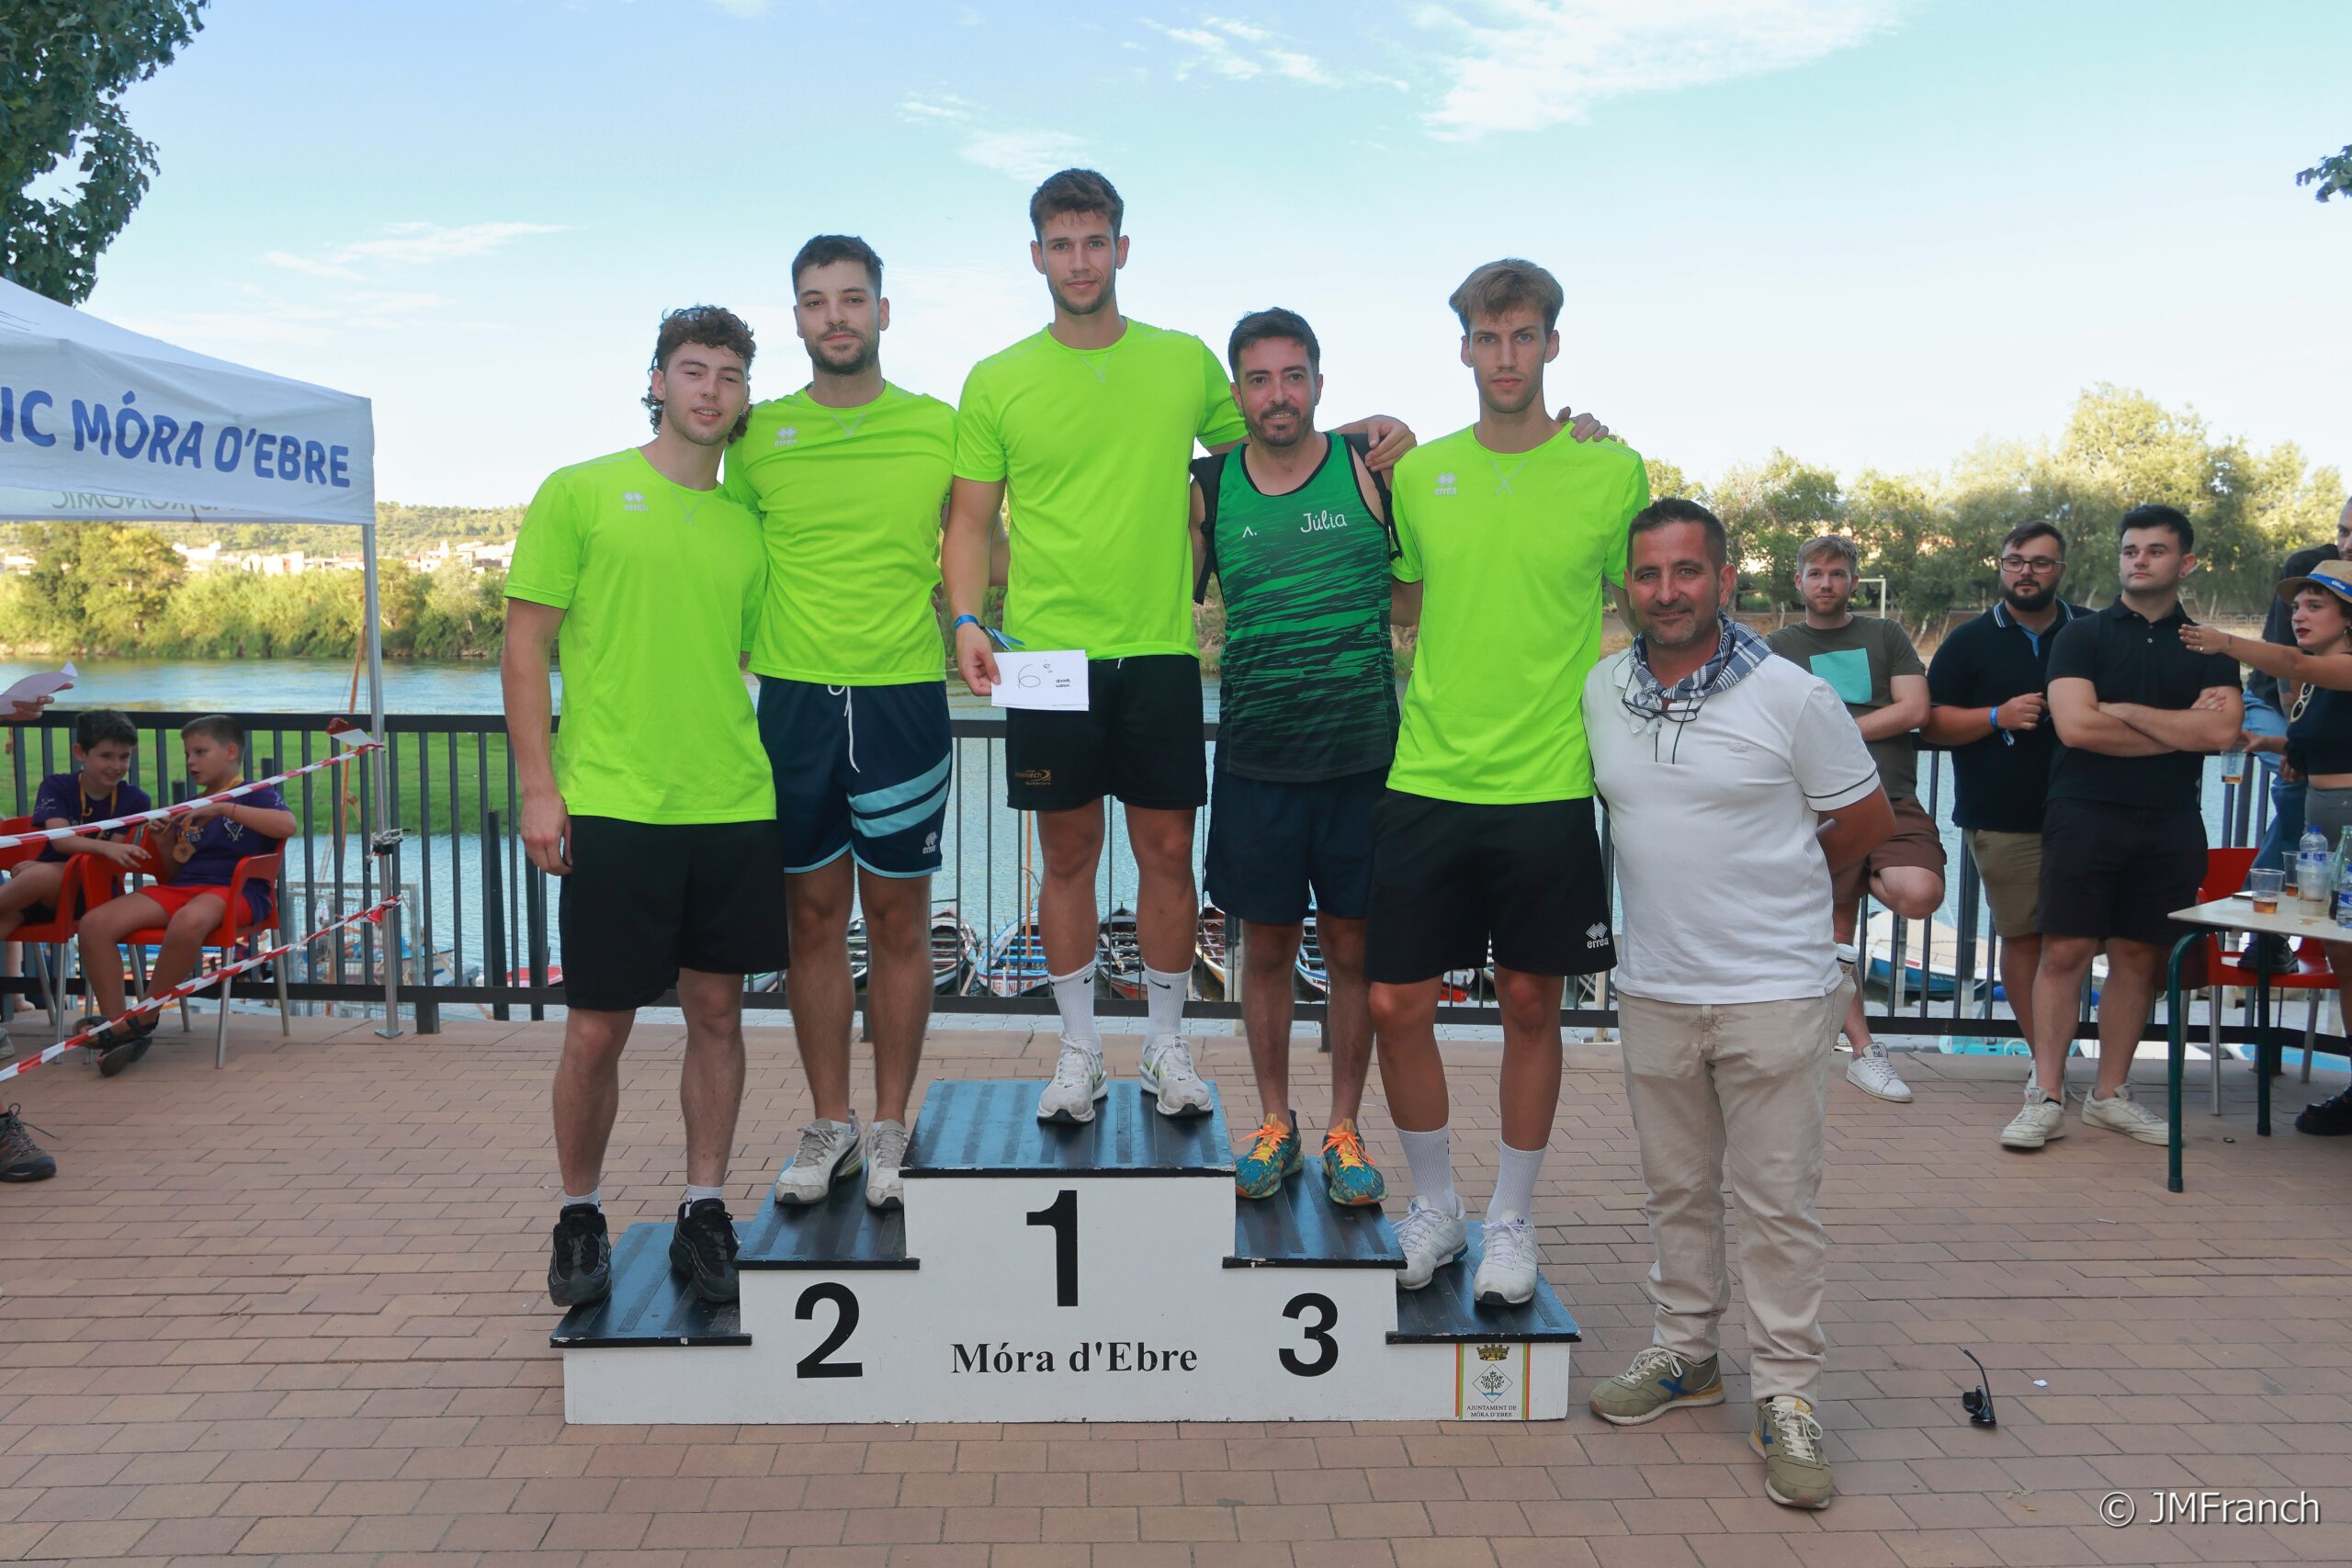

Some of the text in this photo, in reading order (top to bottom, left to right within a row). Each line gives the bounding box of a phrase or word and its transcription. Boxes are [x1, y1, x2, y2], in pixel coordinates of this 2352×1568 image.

[72, 390, 203, 468] MÓRA
[1300, 510, 1347, 533] Júlia
[1026, 1190, 1078, 1307] 1
[795, 1282, 863, 1379] 2
[950, 1341, 1198, 1374] Móra d'Ebre
[1279, 1292, 1339, 1377] 3
